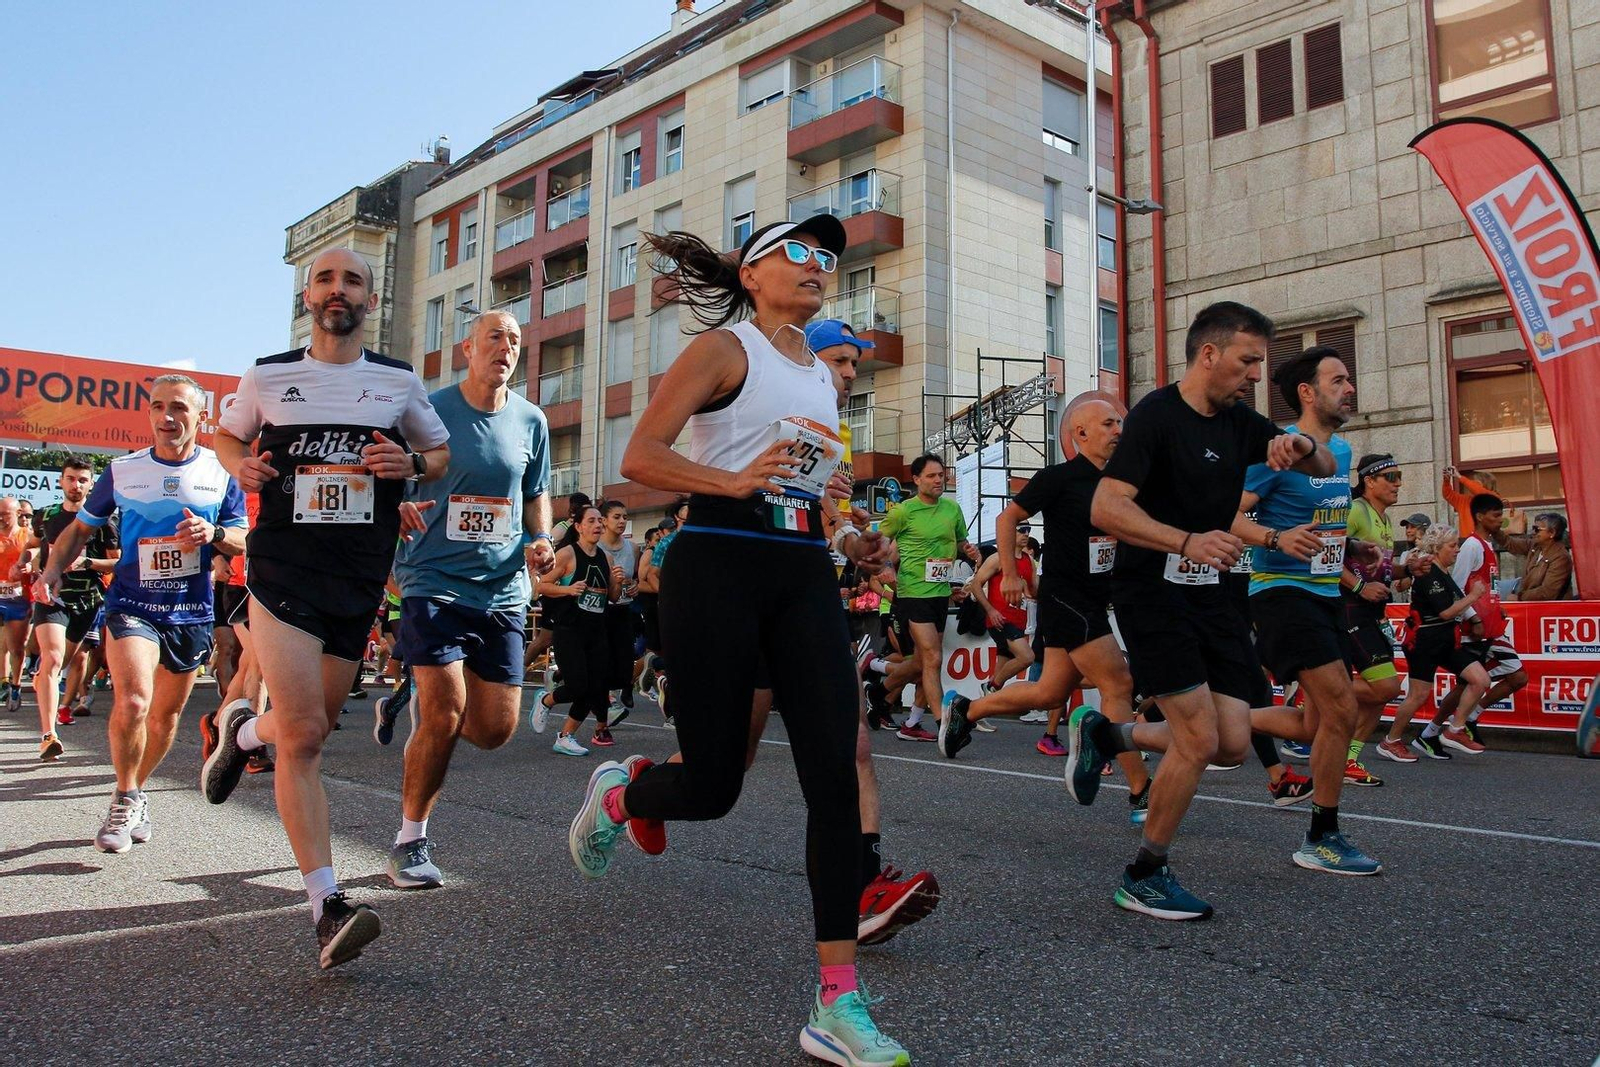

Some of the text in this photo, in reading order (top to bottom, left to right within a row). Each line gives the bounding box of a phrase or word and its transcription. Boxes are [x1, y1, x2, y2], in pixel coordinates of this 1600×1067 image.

[104, 426, 132, 441] 10K
[317, 475, 349, 483] MOLINERO
[317, 484, 348, 511] 181
[459, 511, 495, 533] 333
[153, 550, 183, 571] 168
[1320, 544, 1342, 565] 363
[931, 566, 949, 578] 243
[583, 593, 601, 608] 574
[1543, 617, 1600, 643] FRO
